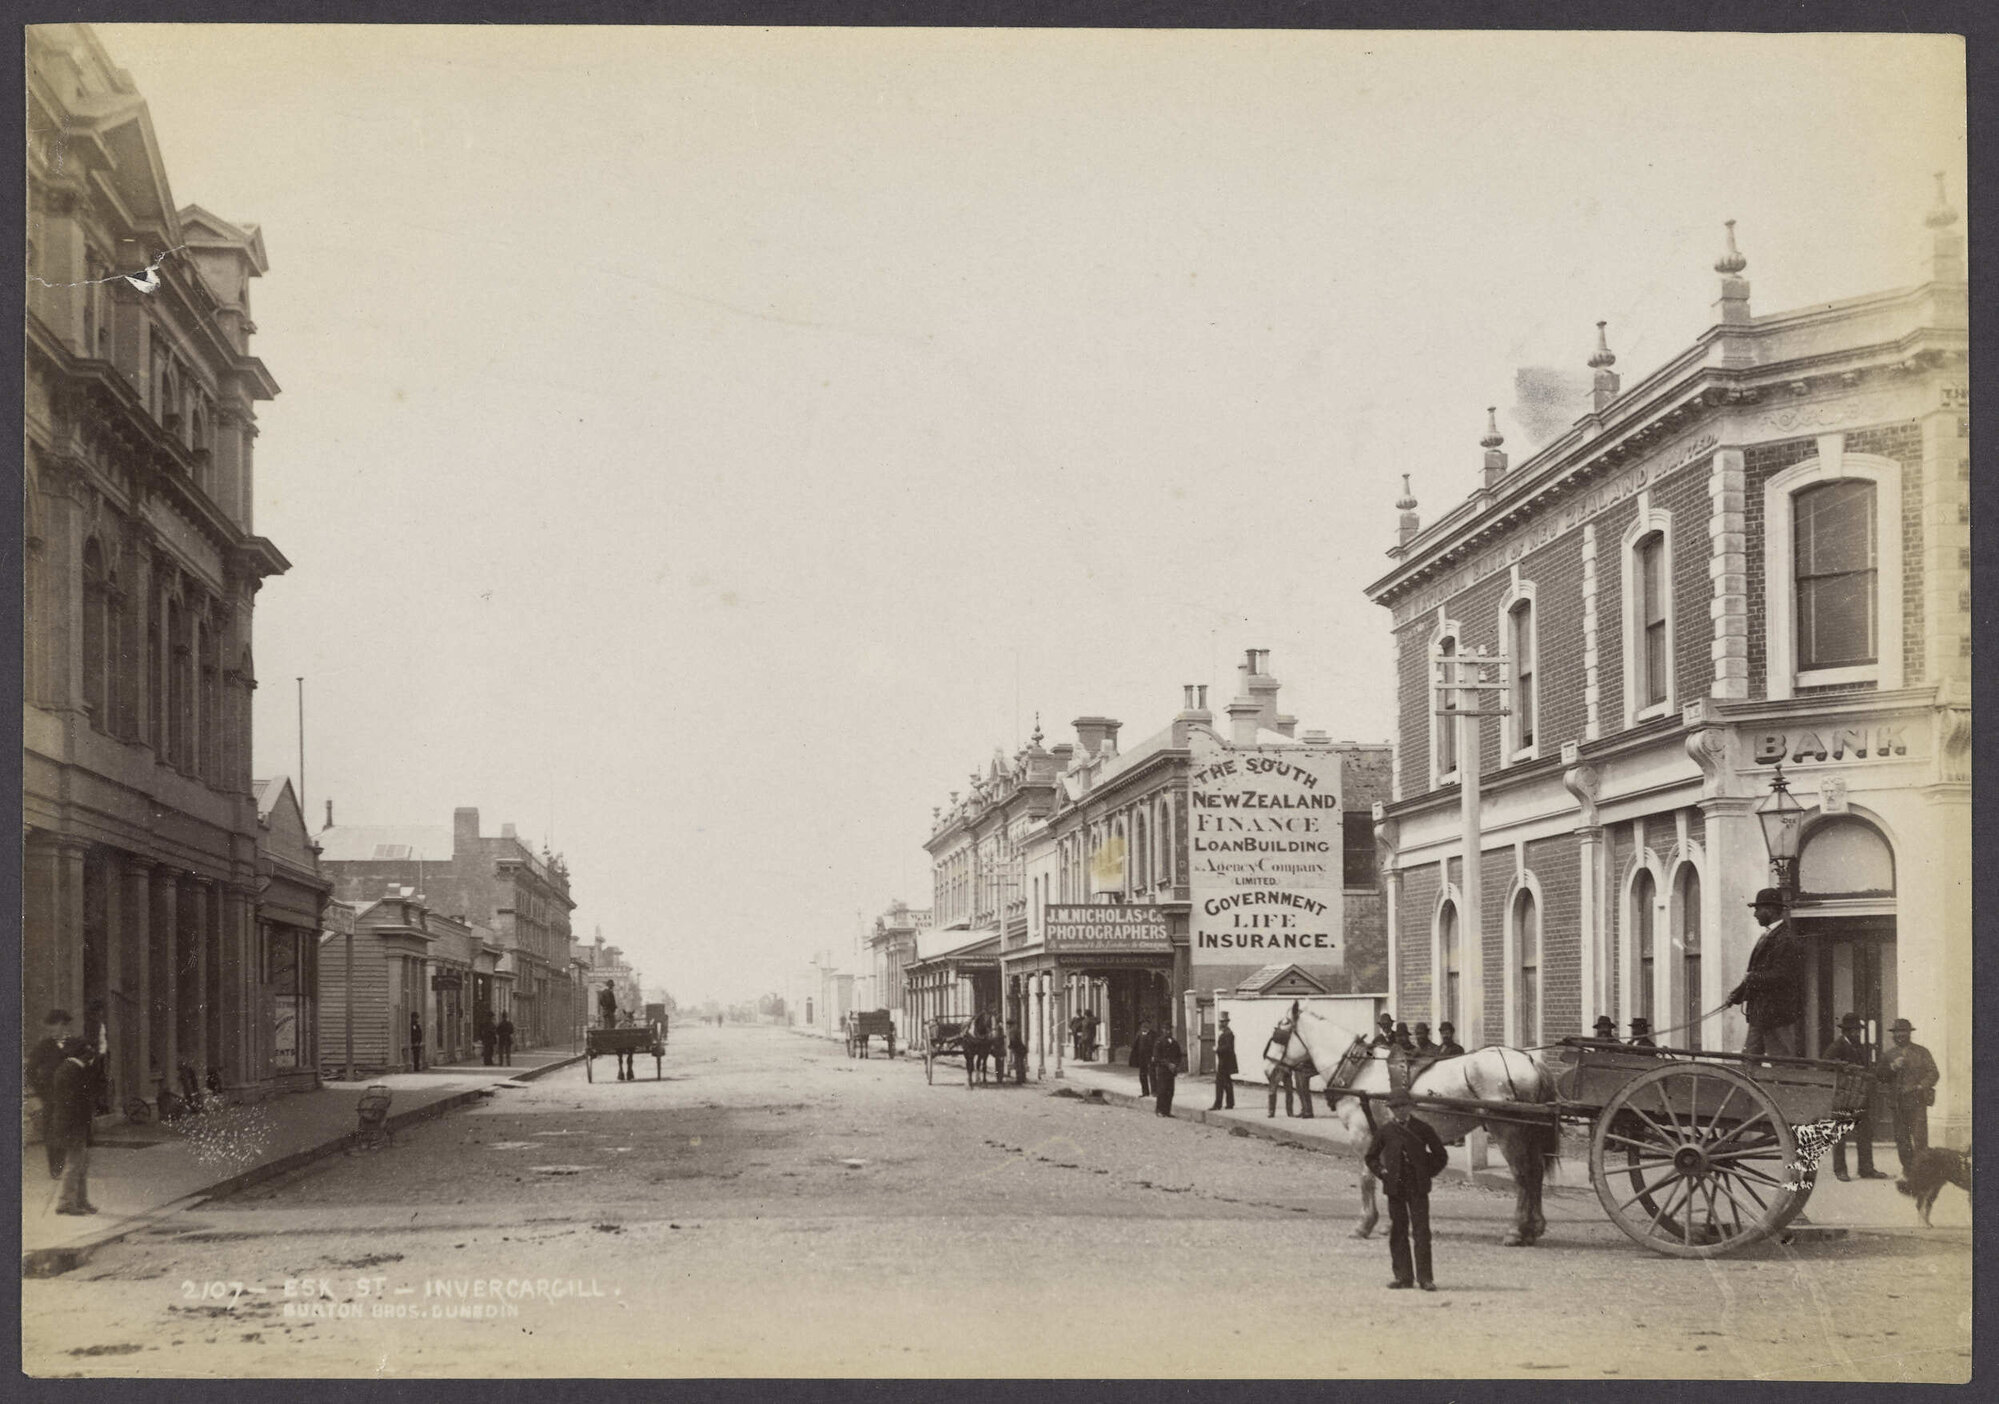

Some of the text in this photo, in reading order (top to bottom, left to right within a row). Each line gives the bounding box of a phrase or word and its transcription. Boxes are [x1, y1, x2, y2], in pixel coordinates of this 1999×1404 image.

[1754, 725, 1907, 765] BANK
[1194, 757, 1318, 789] THE SOUTH
[1197, 814, 1320, 833] FINANCE
[1204, 891, 1328, 916] GOVERNMENT
[1233, 914, 1297, 928] LIFE
[1047, 925, 1167, 939] PHOTOGRAPHERS
[1198, 930, 1336, 948] INSURANCE.
